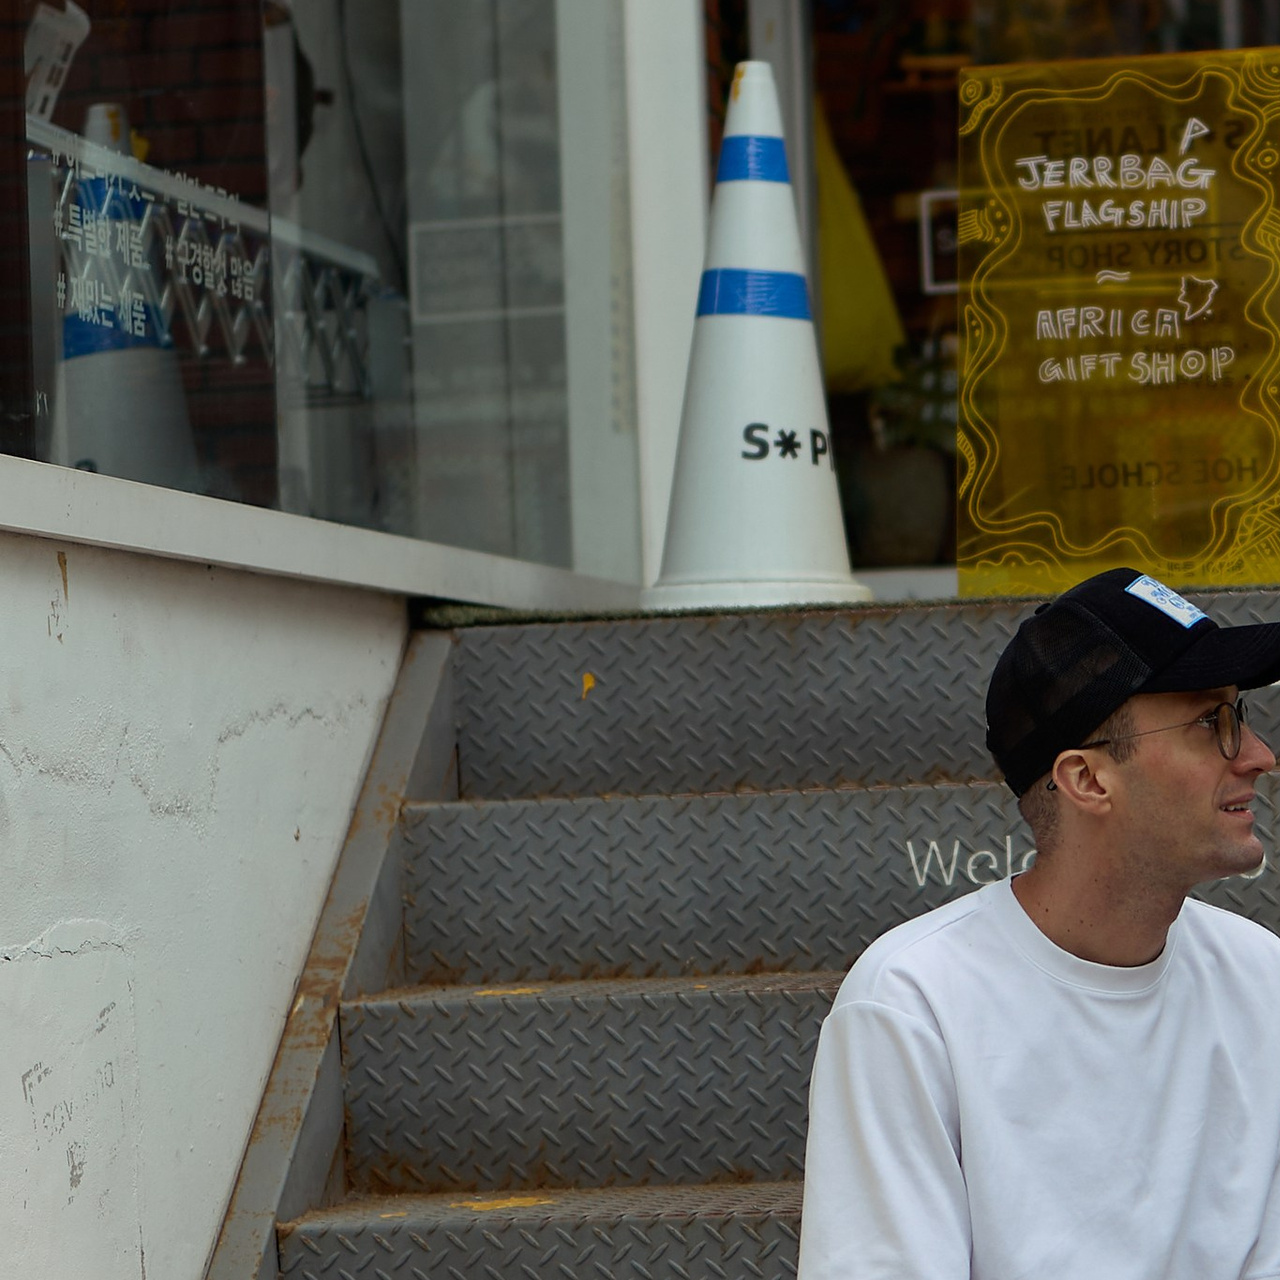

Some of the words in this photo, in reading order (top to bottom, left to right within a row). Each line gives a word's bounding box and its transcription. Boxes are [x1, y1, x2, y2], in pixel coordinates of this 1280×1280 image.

[1016, 154, 1215, 190] JERRBAG
[1041, 198, 1207, 232] FLAGSHIP
[115, 221, 145, 268] 제품
[119, 287, 147, 338] 제품
[1037, 306, 1182, 340] AFRICA
[1039, 352, 1123, 384] GIFT
[1129, 347, 1235, 385] SHOP
